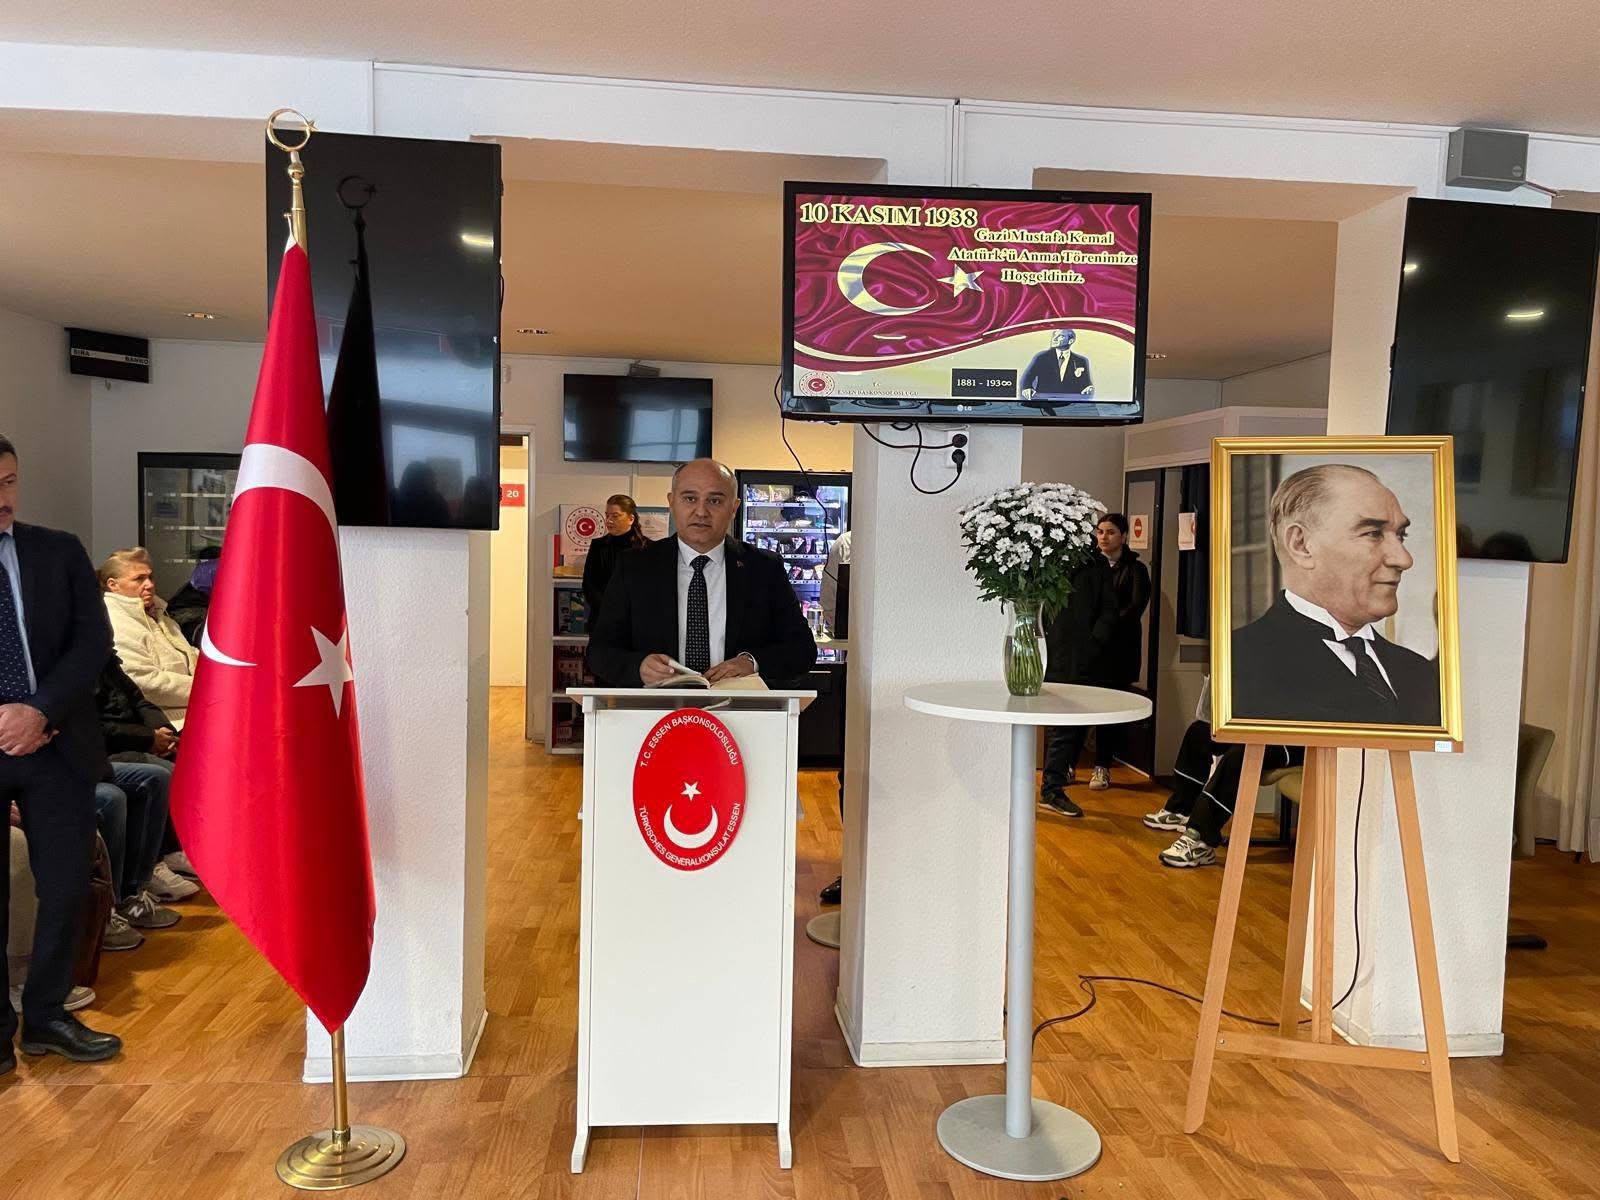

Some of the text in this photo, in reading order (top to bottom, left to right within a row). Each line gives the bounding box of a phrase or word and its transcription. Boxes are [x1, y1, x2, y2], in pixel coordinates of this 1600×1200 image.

[801, 203, 977, 227] 10 KASIM 1938
[975, 229, 1114, 245] Gazi Mustafa Kemal
[1019, 250, 1061, 263] Anma
[1062, 250, 1137, 265] Törenimize
[1002, 269, 1085, 284] Hoşgeldiniz.
[957, 378, 976, 387] 1881
[506, 490, 519, 498] 20
[648, 722, 672, 749] ESSEN
[665, 831, 731, 866] GENERALKONSULAT
[727, 803, 741, 832] ESSEN
